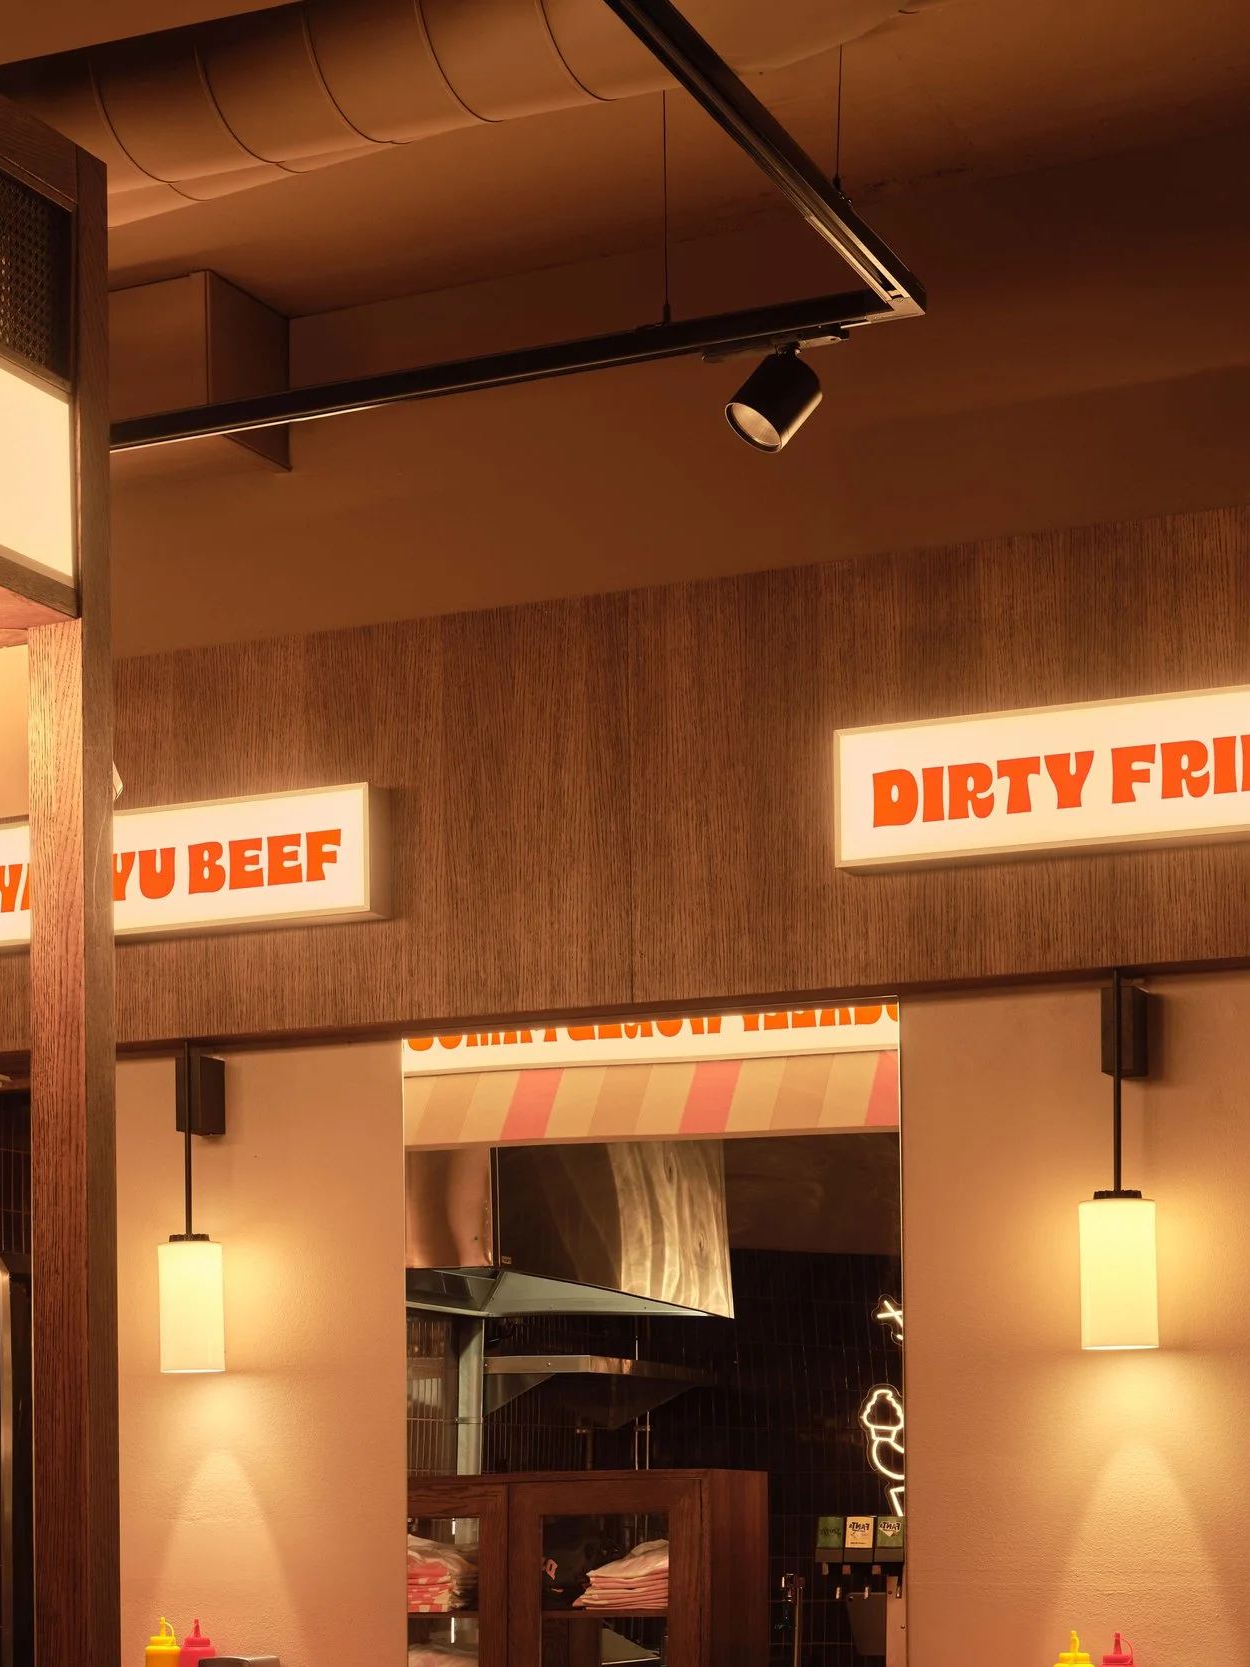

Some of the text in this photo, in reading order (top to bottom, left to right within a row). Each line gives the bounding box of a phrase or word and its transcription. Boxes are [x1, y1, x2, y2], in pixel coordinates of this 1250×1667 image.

[872, 733, 1250, 829] DIRTY FRI
[187, 828, 343, 896] BEEF
